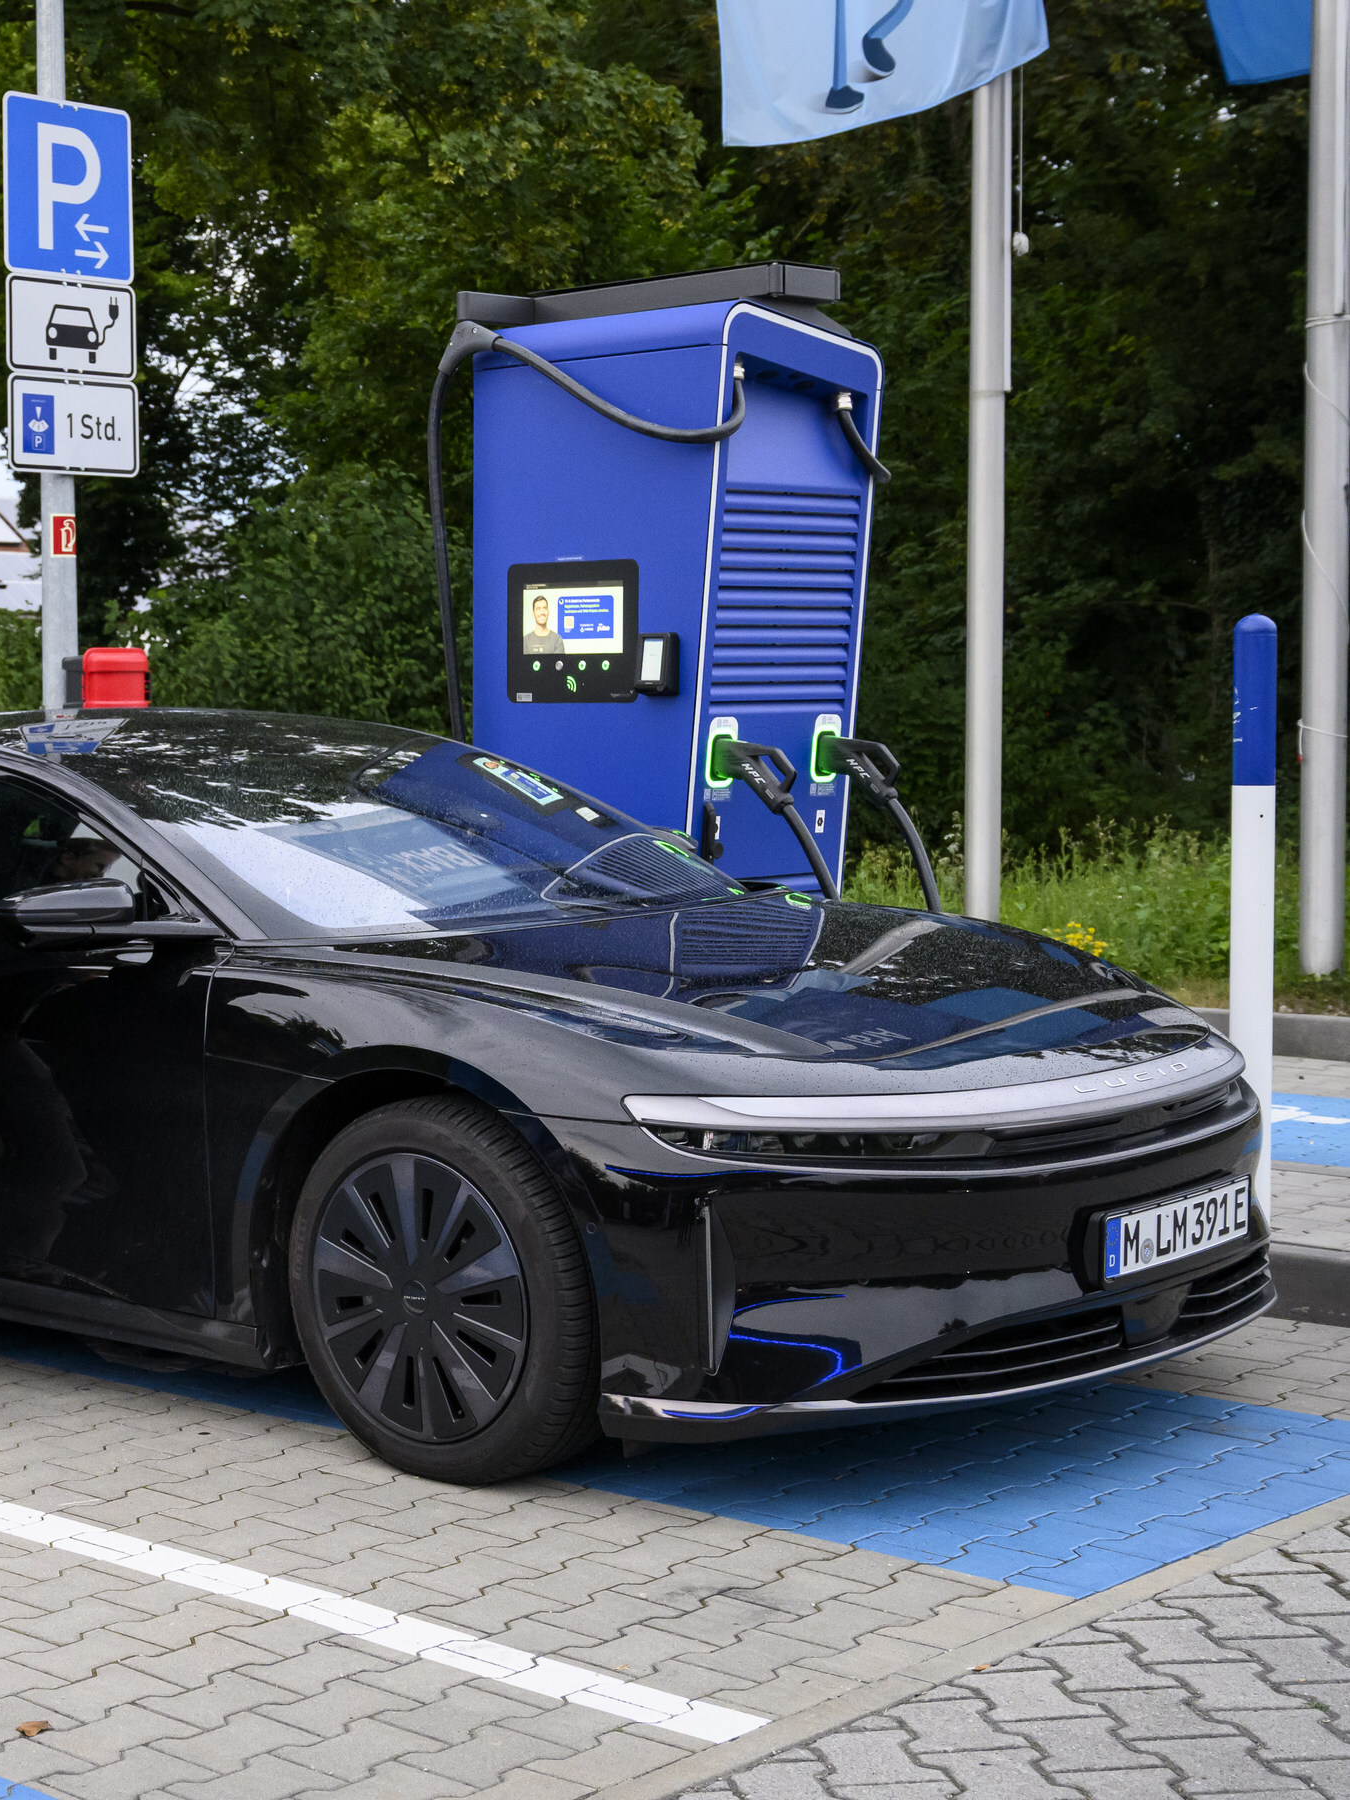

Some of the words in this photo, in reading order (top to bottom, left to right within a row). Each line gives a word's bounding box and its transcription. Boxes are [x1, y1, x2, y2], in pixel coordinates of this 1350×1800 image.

[37, 122, 102, 251] P
[66, 412, 73, 439] 1
[80, 413, 122, 442] Std.
[34, 435, 43, 448] P
[740, 762, 767, 785] HPC
[845, 758, 872, 779] HPC
[1072, 1061, 1188, 1094] LUCID
[1123, 1219, 1140, 1267] M
[1108, 1254, 1115, 1268] D
